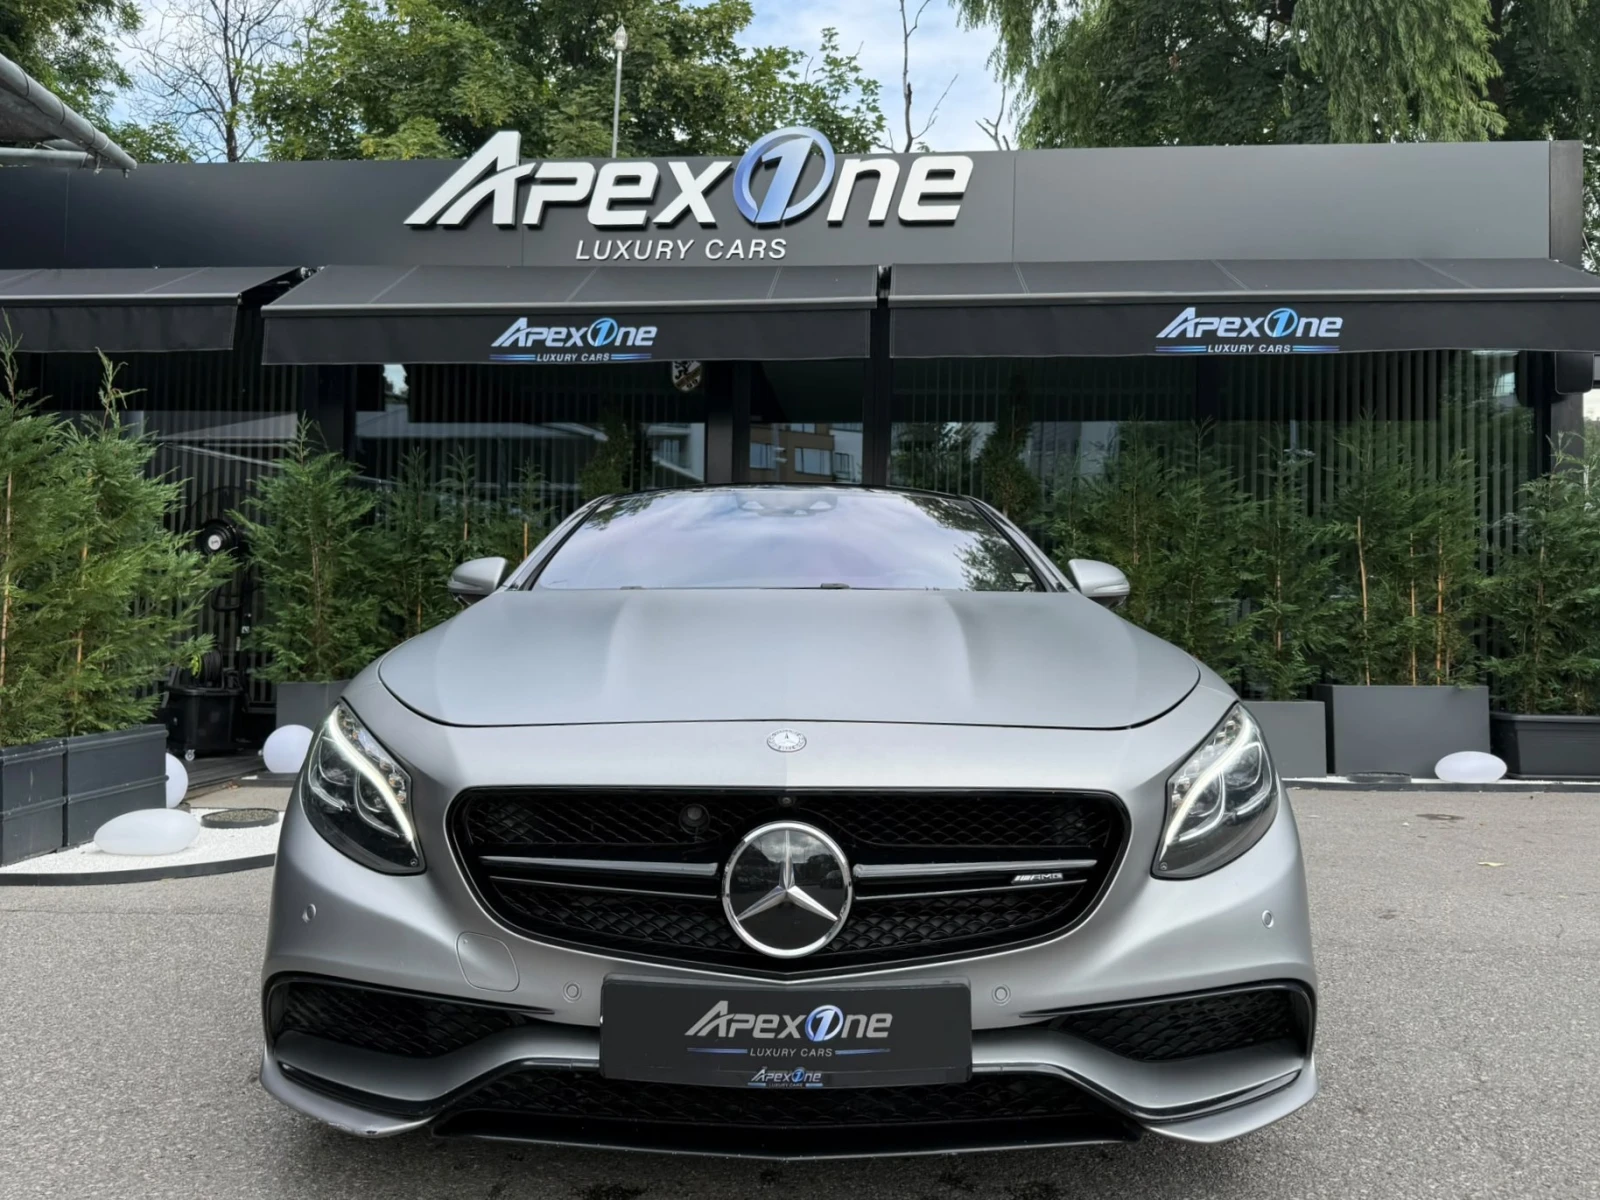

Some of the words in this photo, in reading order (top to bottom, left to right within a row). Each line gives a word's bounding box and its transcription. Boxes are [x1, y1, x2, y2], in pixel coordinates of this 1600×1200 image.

[576, 240, 694, 260] LUXURY
[705, 239, 787, 260] CARS
[1207, 344, 1254, 353] LUXURY
[1258, 344, 1291, 353] CARS
[536, 353, 579, 362] LUXURY
[581, 352, 610, 362] CARS
[750, 1048, 797, 1057] LUXURY
[800, 1048, 833, 1057] CARS
